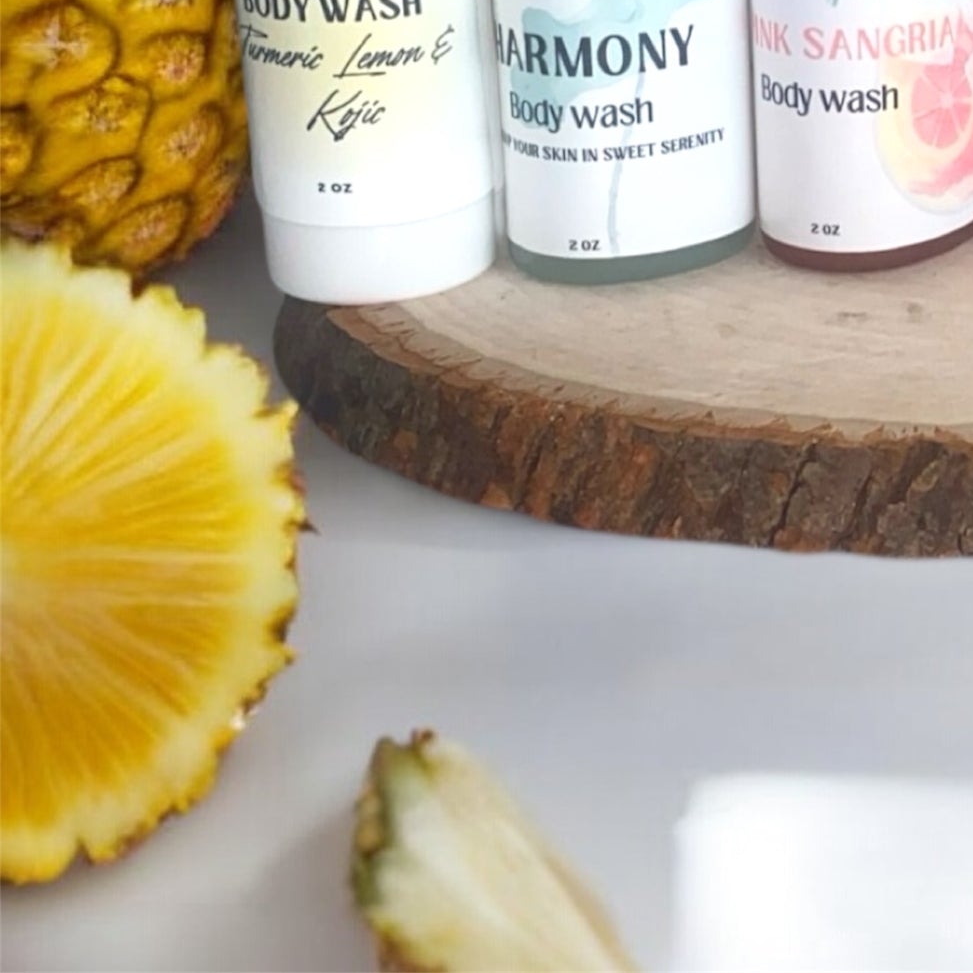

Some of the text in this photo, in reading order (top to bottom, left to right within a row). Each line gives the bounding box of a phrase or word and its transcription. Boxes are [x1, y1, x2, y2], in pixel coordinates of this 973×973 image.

[239, 24, 455, 79] Turmeric Lemon &
[494, 22, 695, 78] HARMONY
[753, 12, 955, 60] INK SANGRIA
[306, 90, 386, 142] Kojic
[509, 91, 654, 134] Body wash
[761, 72, 899, 117] Body wash
[512, 137, 539, 159] YOUR
[543, 145, 578, 163] SKIN
[582, 147, 599, 163] IN
[603, 142, 657, 162] SWEET
[660, 127, 725, 155] SERENITY
[317, 182, 353, 194] 2 OZ
[568, 239, 601, 251] 2 OZ
[811, 223, 841, 236] 2 OZ
